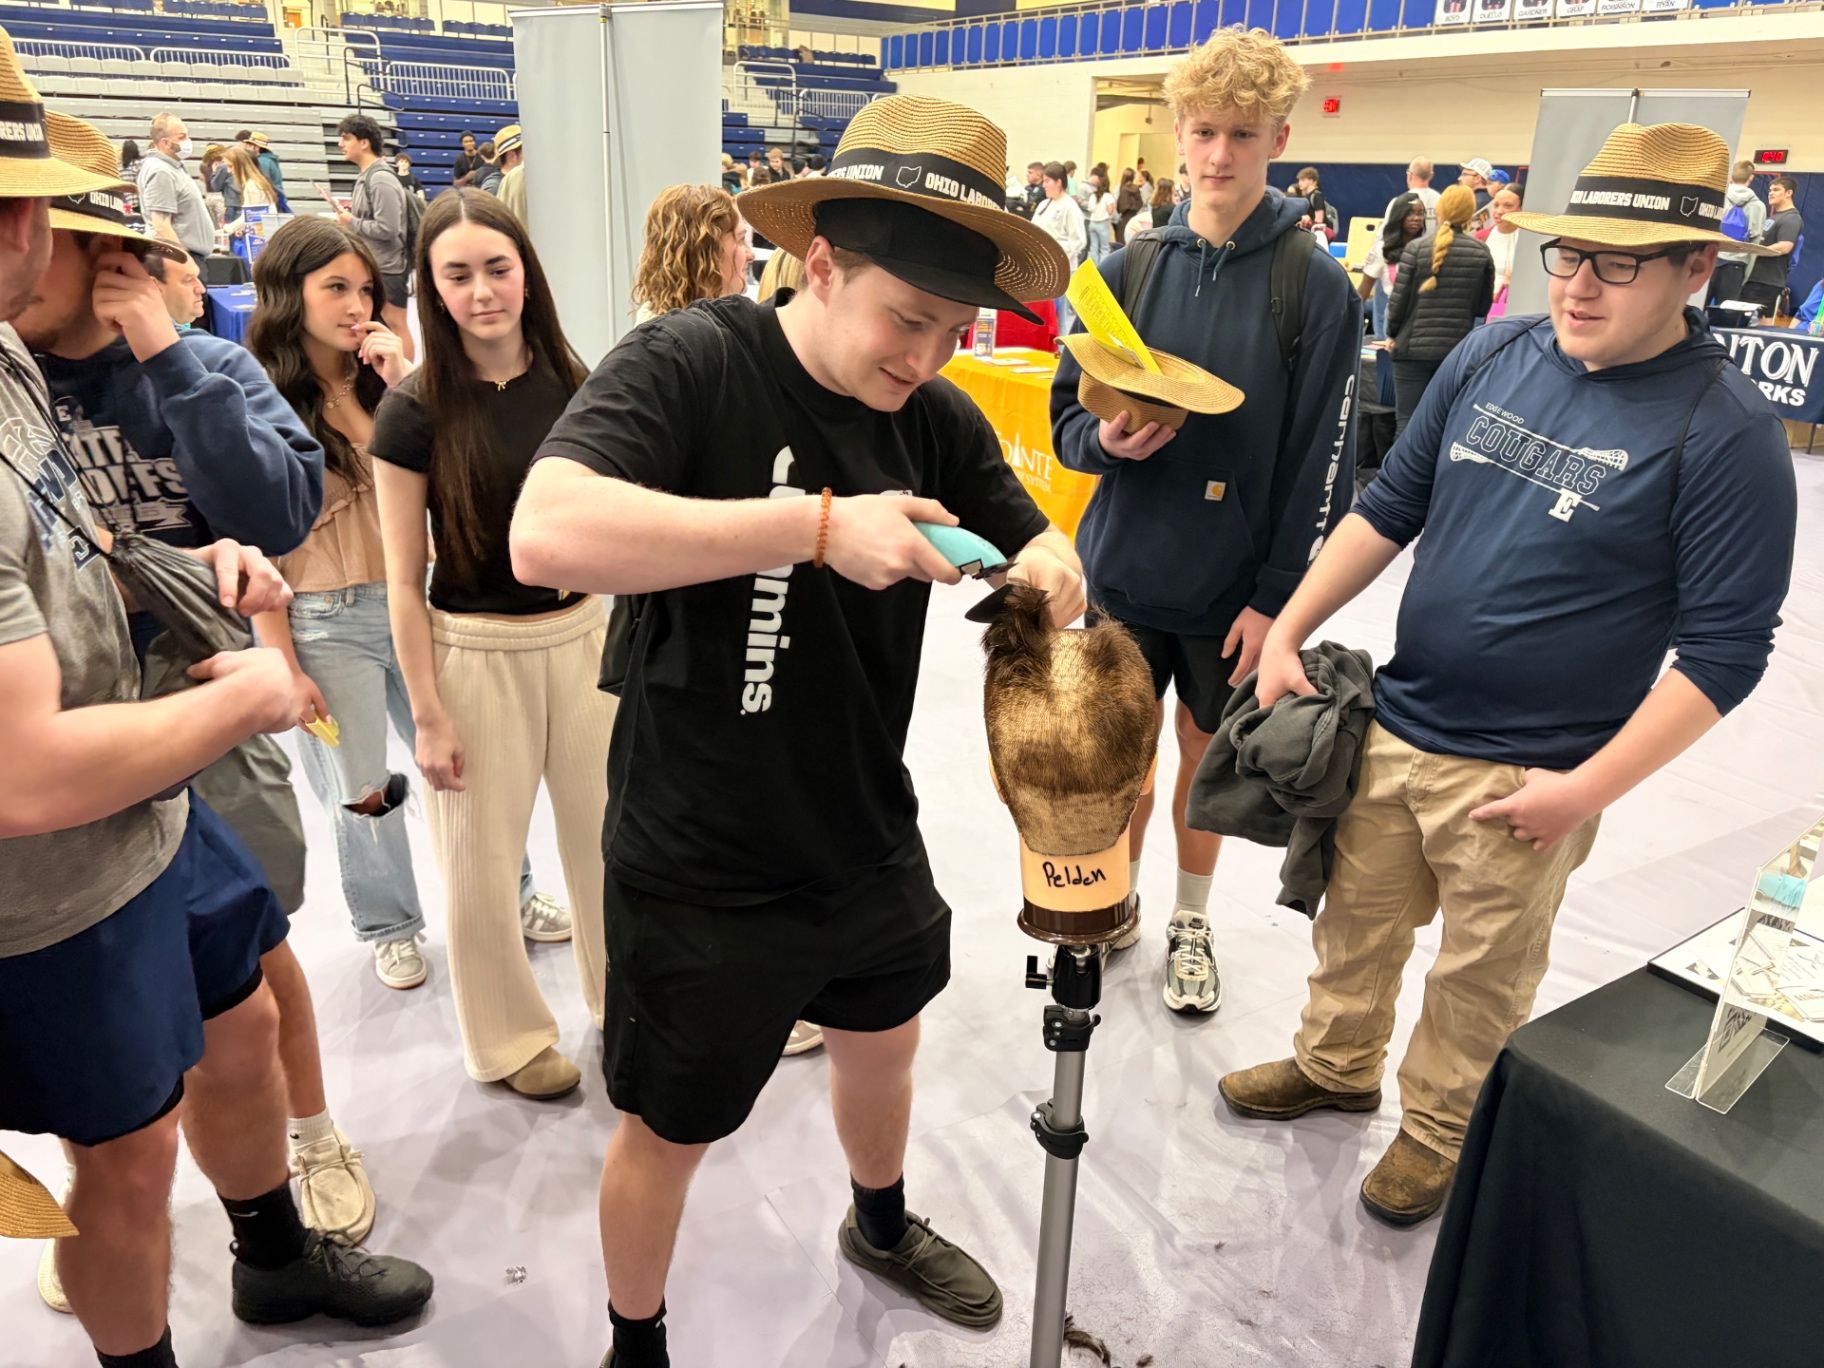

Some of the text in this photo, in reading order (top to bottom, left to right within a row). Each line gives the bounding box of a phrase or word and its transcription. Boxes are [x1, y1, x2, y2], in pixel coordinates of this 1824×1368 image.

[847, 164, 884, 180] UNION
[925, 172, 959, 198] OHIO
[90, 191, 110, 208] OHIO
[1582, 190, 1633, 207] LABORERS
[1632, 194, 1670, 211] UNION
[1753, 379, 1806, 406] RKS
[1466, 415, 1607, 496] COUGARS
[1548, 487, 1583, 523] E
